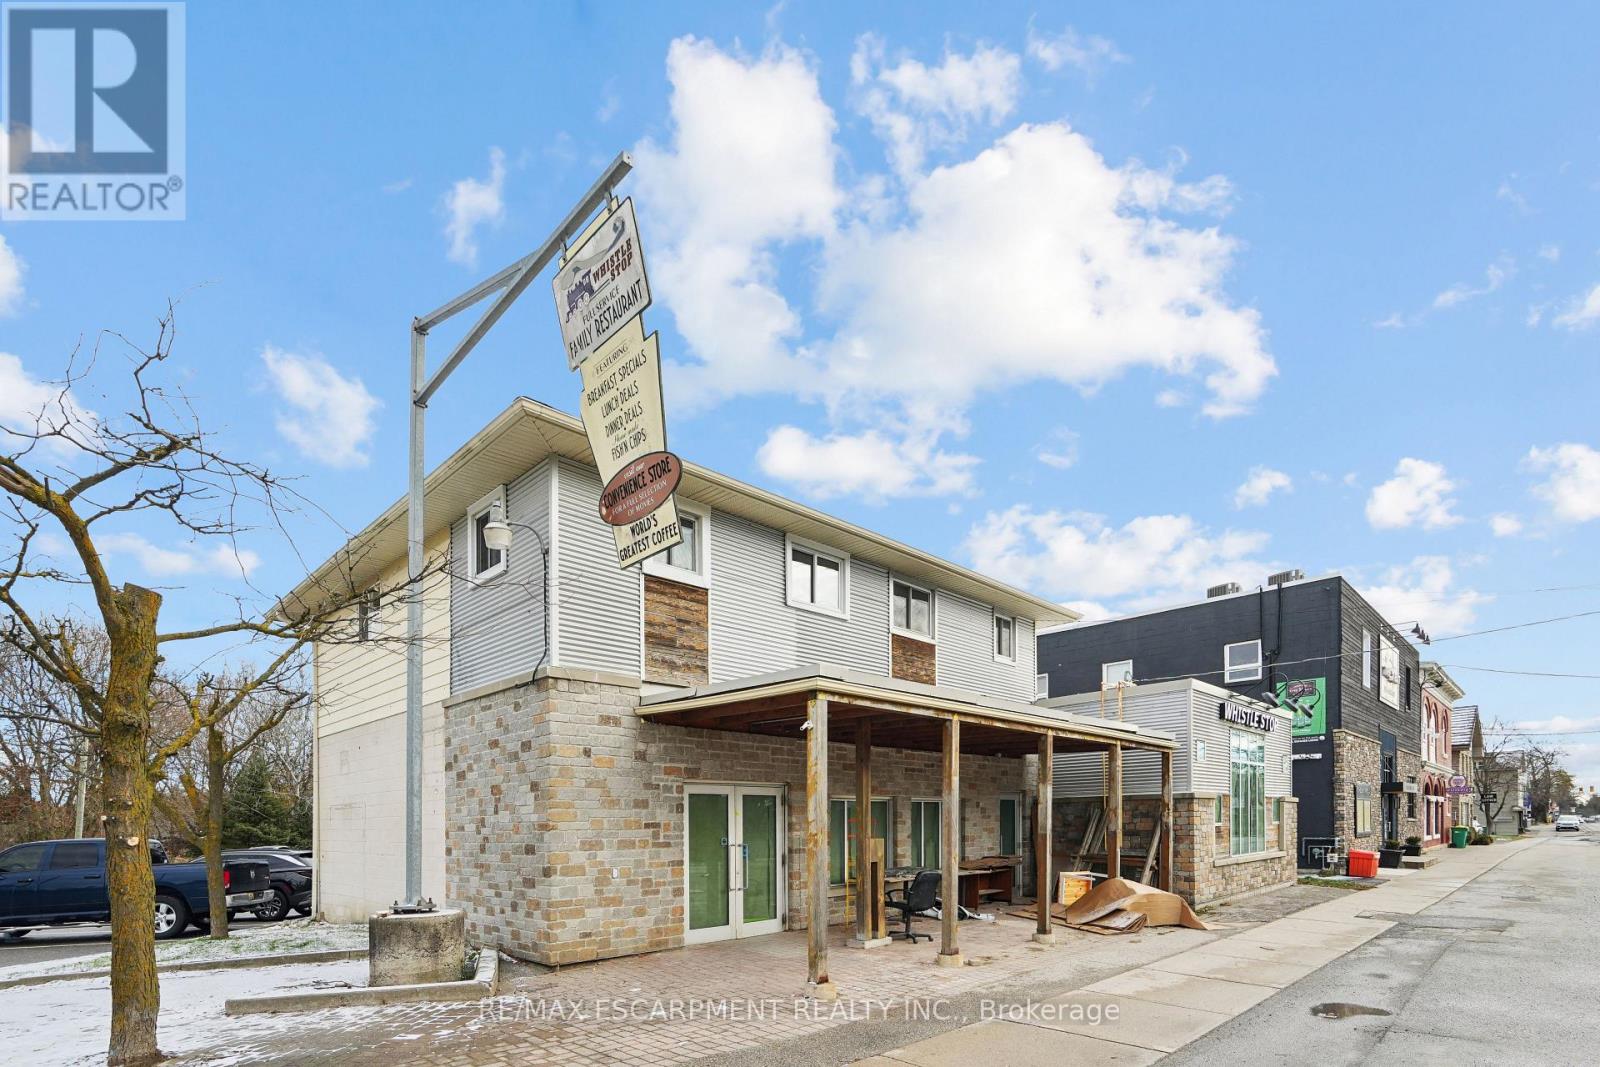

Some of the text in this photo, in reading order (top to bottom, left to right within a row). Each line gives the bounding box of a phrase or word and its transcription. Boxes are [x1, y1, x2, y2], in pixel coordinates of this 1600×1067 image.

[592, 238, 632, 283] WHISTLE
[610, 254, 633, 282] STOP
[596, 284, 621, 313] SERVICE
[569, 279, 643, 360] FAMILY RESTAURANT
[596, 343, 628, 376] FEATURING
[587, 349, 647, 407] BREAKFAST SPECIALS
[601, 380, 639, 418] LUNCH DEALS
[605, 401, 643, 438] DINNER DEALS
[629, 427, 647, 451] CHIPS
[603, 456, 672, 509] CONVENIENCE STORE
[639, 479, 667, 500] SELECTION
[635, 497, 654, 512] MOVIES
[619, 522, 679, 561] GREATEST COFFEE
[629, 513, 658, 537] WORLD'S
[1224, 701, 1278, 733] WHISTLE STOP
